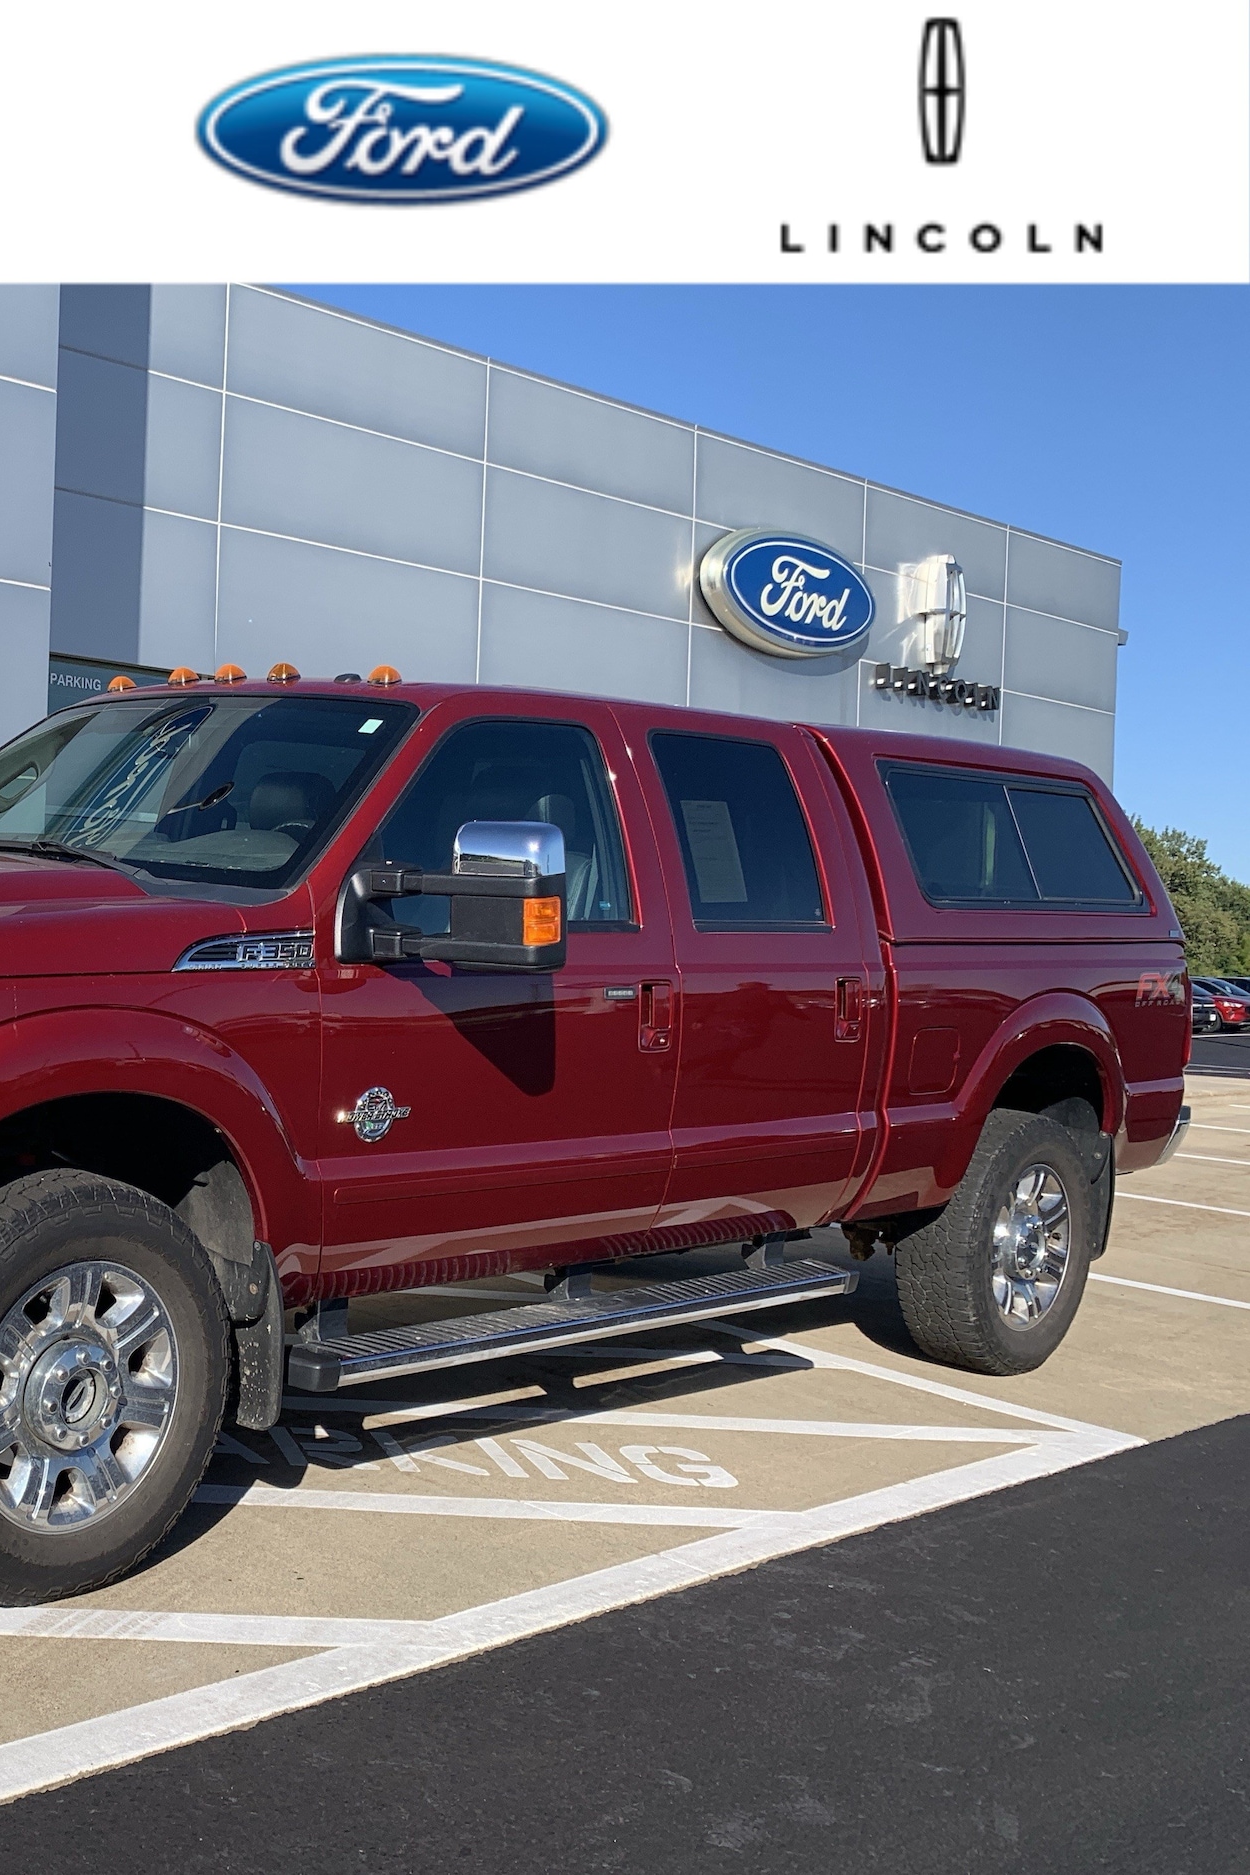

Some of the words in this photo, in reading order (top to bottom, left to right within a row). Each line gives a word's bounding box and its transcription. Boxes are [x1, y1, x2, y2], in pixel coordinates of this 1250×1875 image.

[760, 555, 851, 632] Ford
[50, 672, 102, 691] PARKING
[1136, 972, 1184, 1000] FX4
